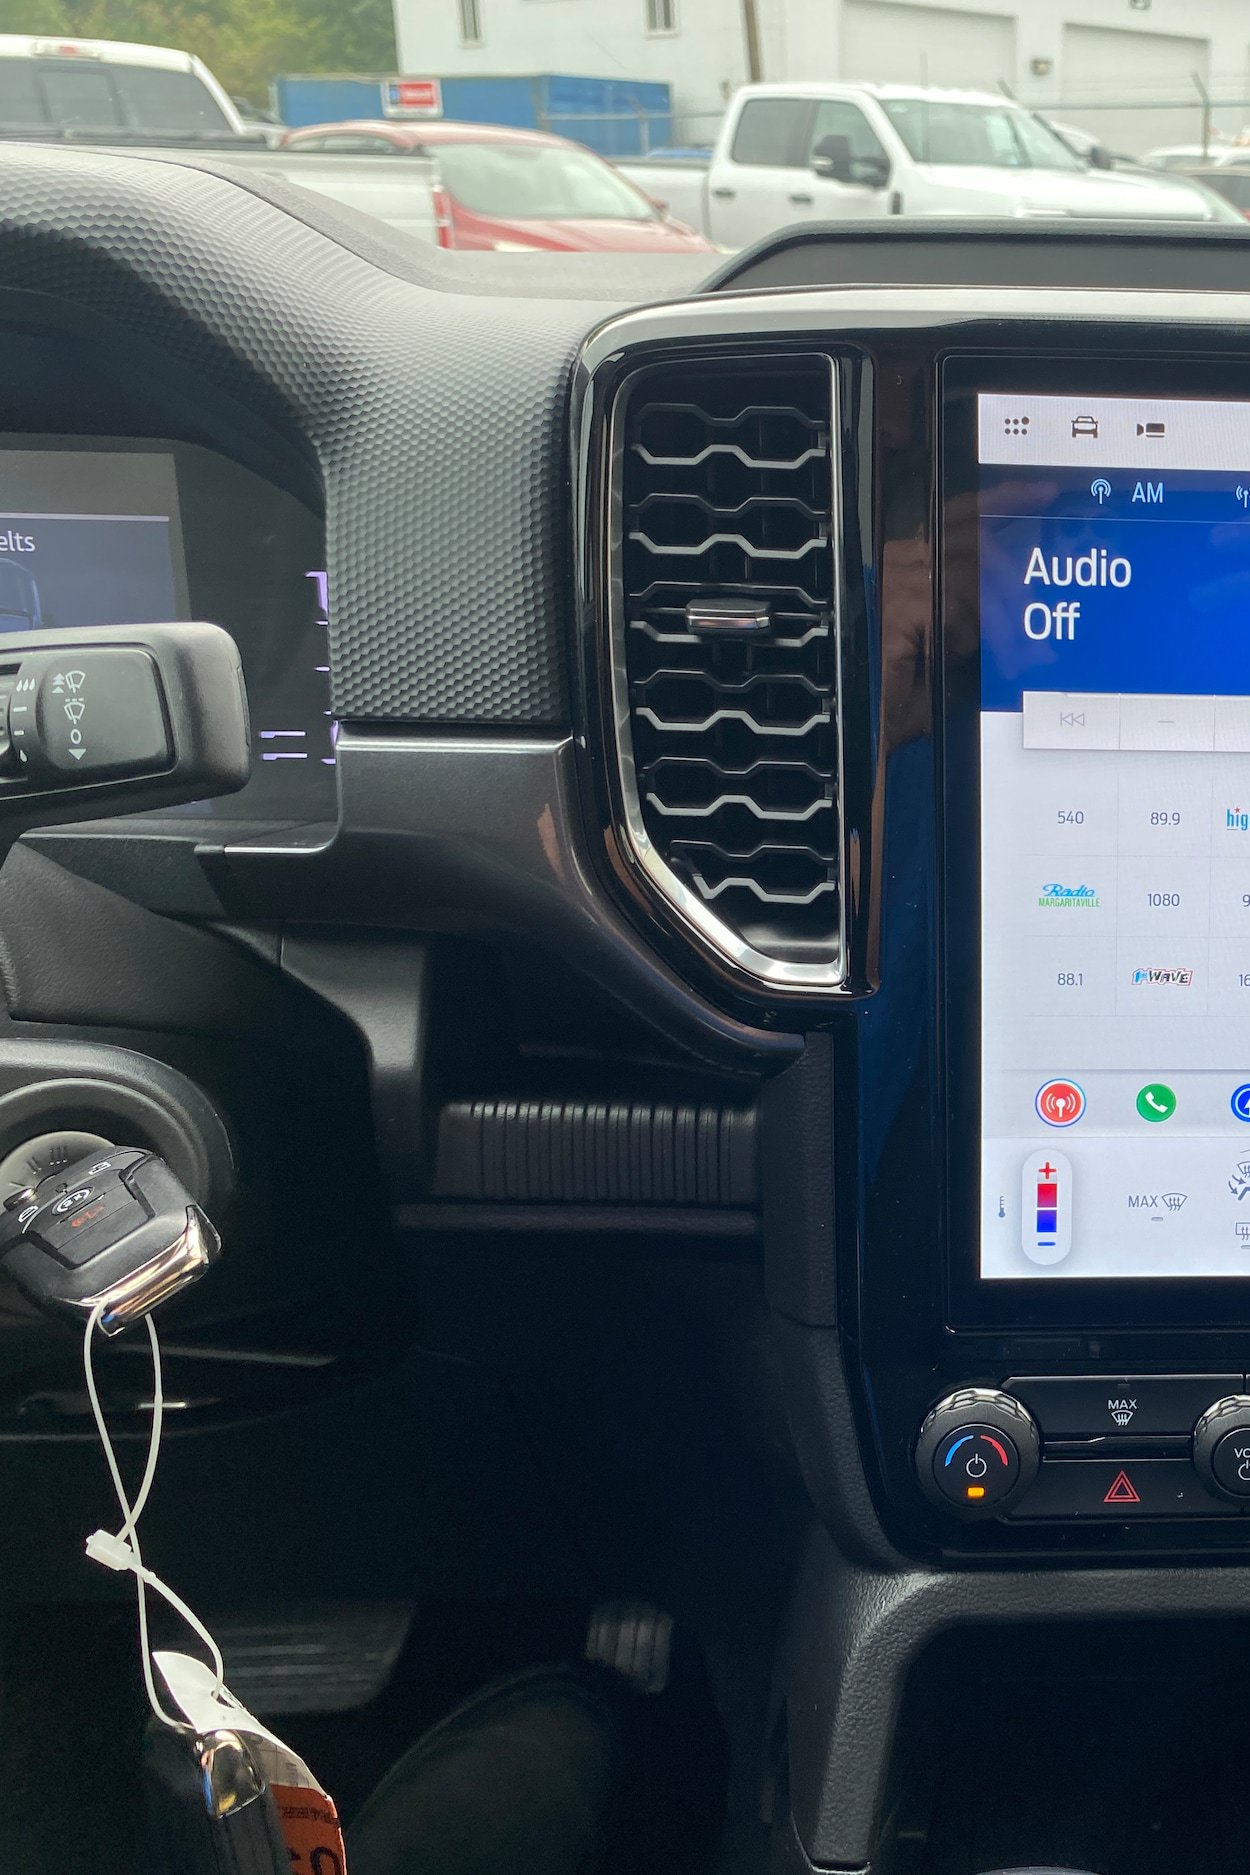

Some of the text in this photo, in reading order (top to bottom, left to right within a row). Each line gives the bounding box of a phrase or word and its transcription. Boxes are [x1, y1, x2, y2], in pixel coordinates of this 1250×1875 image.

[1131, 482, 1164, 504] AM
[1023, 547, 1132, 588] Audio
[1023, 601, 1081, 640] Off
[1057, 810, 1085, 825] 540
[1150, 811, 1181, 826] 89.9
[1042, 883, 1096, 897] Radio
[1038, 897, 1101, 907] MARGARITAVILLE
[1148, 893, 1180, 907] 1080
[1057, 972, 1083, 986] 88.1
[1128, 1194, 1159, 1208] MAX
[1107, 1399, 1138, 1410] MAX
